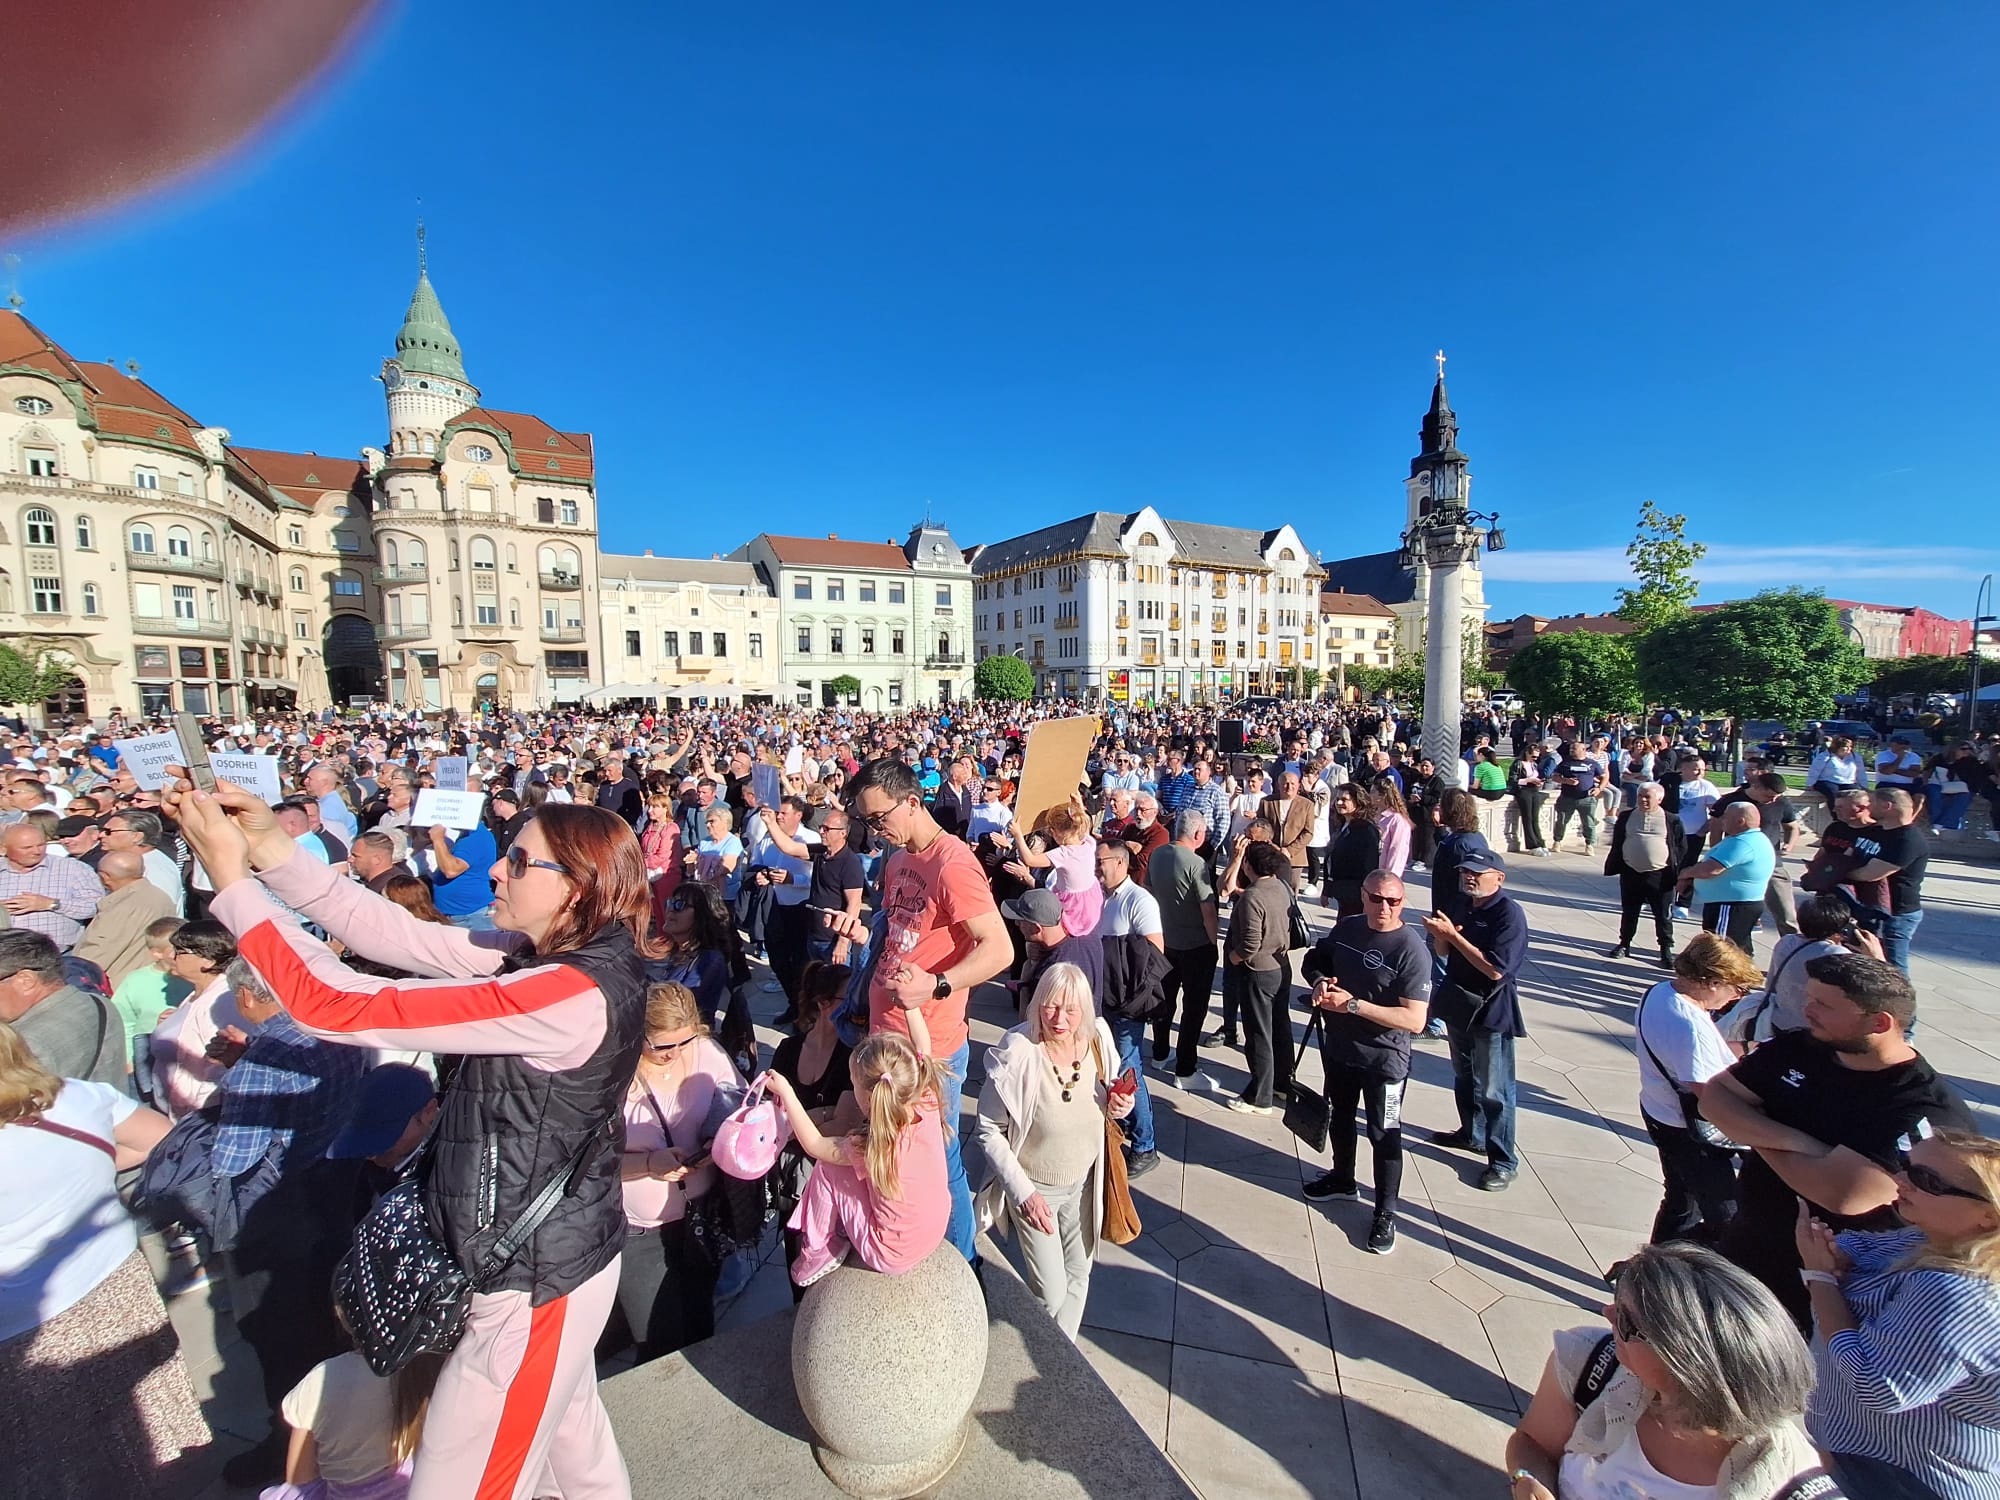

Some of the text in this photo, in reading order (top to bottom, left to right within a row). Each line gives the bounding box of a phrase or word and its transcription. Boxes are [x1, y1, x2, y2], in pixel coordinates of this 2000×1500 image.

[146, 771, 171, 781] BOLO
[1386, 1094, 1397, 1120] ARMANI
[1586, 1339, 1617, 1392] GERFELD
